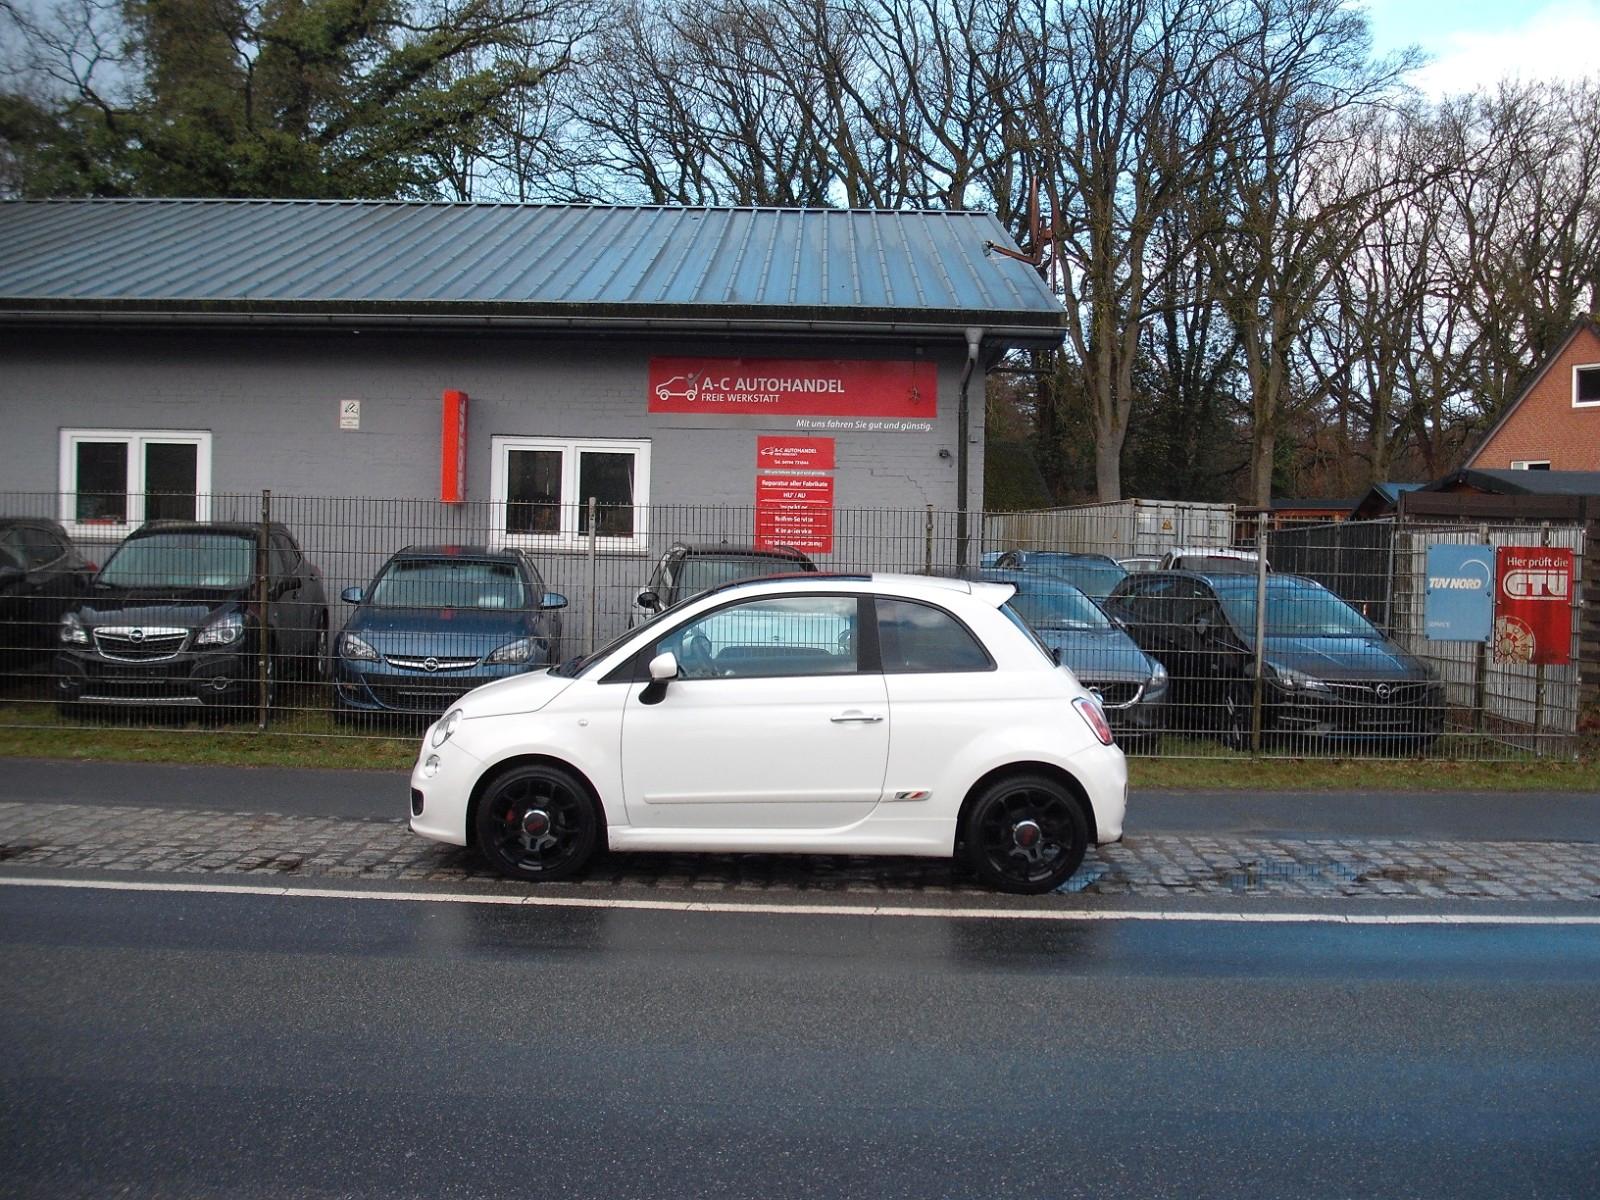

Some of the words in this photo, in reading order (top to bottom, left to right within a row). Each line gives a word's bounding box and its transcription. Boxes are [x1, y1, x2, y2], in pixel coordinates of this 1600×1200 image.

[702, 377, 730, 391] A-C
[734, 378, 845, 393] AUTOHANDEL
[701, 393, 724, 402] FREIE
[727, 394, 780, 403] WERKSTATT
[796, 419, 810, 428] Mit
[826, 420, 854, 430] fahren
[855, 420, 868, 429] Sie
[868, 421, 883, 431] gut
[883, 421, 900, 430] und
[901, 421, 934, 432] günstig.
[457, 400, 466, 497] MOTUL
[1507, 557, 1527, 567] Hier
[1528, 557, 1552, 569] prüft
[1553, 557, 1569, 568] die
[1449, 578, 1481, 590] NORD
